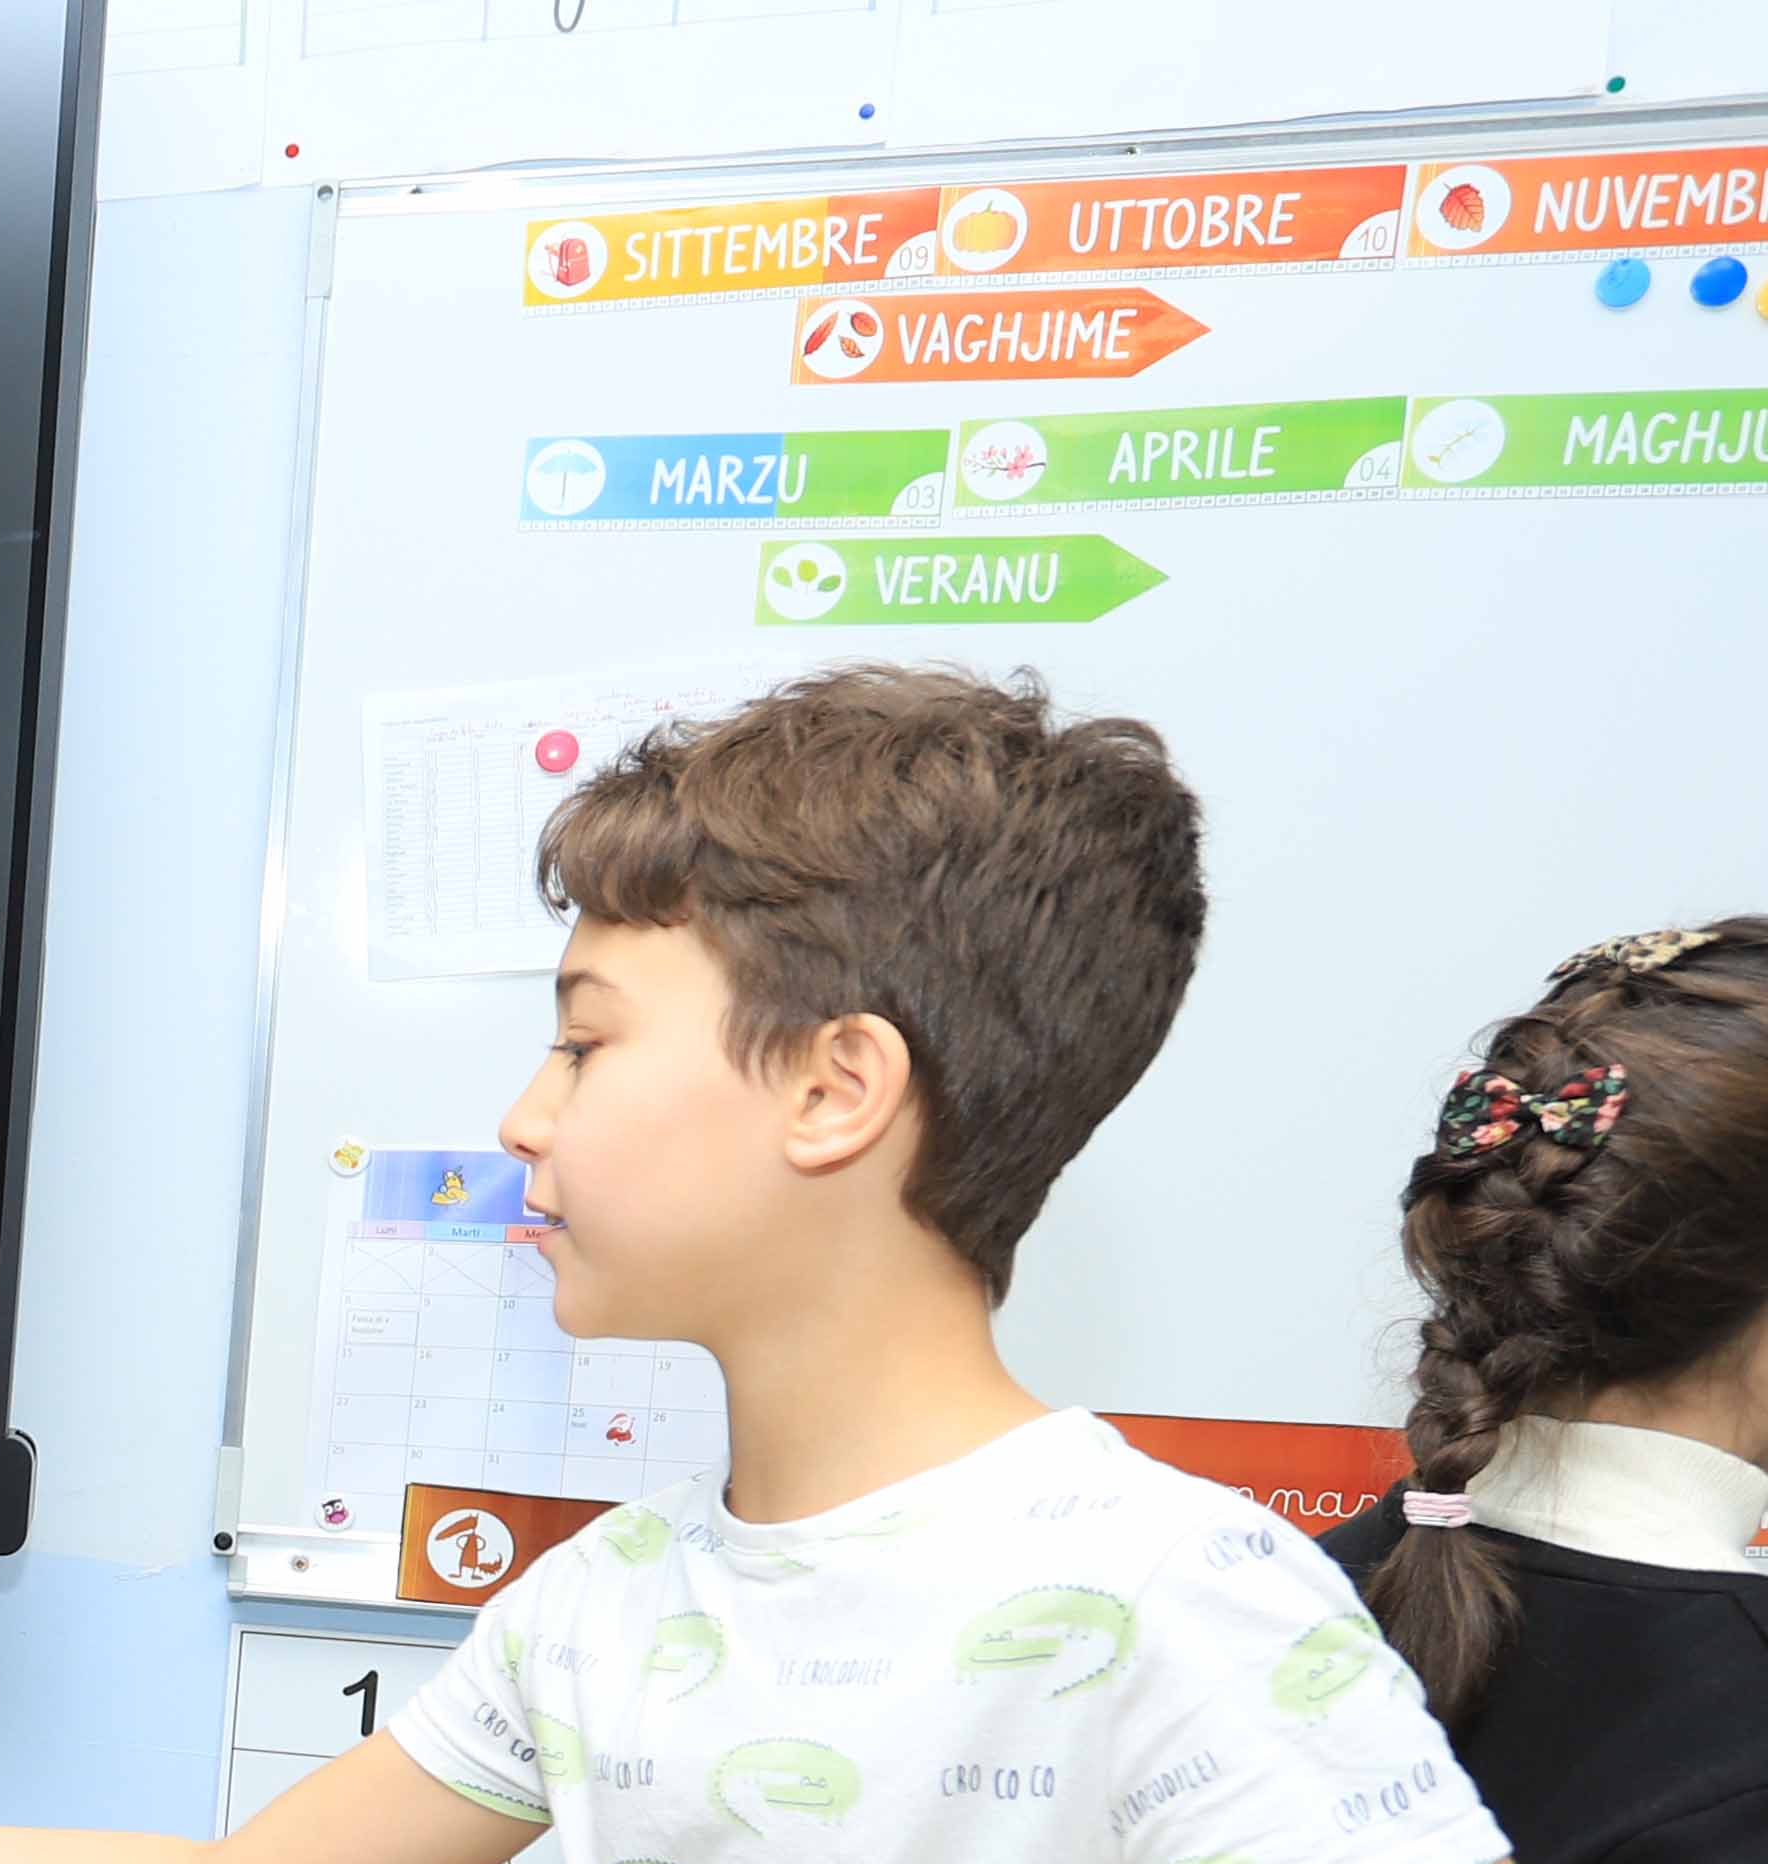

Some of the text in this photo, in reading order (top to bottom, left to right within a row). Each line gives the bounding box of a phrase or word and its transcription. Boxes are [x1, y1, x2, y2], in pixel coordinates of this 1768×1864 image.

[624, 213, 929, 282] SITTEMBRE 09
[1067, 193, 1389, 254] UTTOBRE 10
[897, 307, 1138, 365] VAGHJIME
[1107, 425, 1392, 483] APRILE 04
[650, 455, 808, 505] MARZU
[906, 484, 936, 512] 03
[874, 554, 1060, 606] VERANU
[375, 1224, 541, 1239] Luni Marti Me
[502, 1299, 516, 1310] 10
[497, 1352, 511, 1362] 17
[577, 1356, 591, 1367] 18
[658, 1360, 672, 1371] 19
[572, 1407, 585, 1418] 25
[653, 1412, 667, 1423] 26
[342, 1669, 379, 1738] 1
[473, 1701, 537, 1763] CRO CO
[941, 1763, 1056, 1801] CRO CO CO
[1380, 1780, 1410, 1818] CO
[1413, 1758, 1437, 1794] CO
